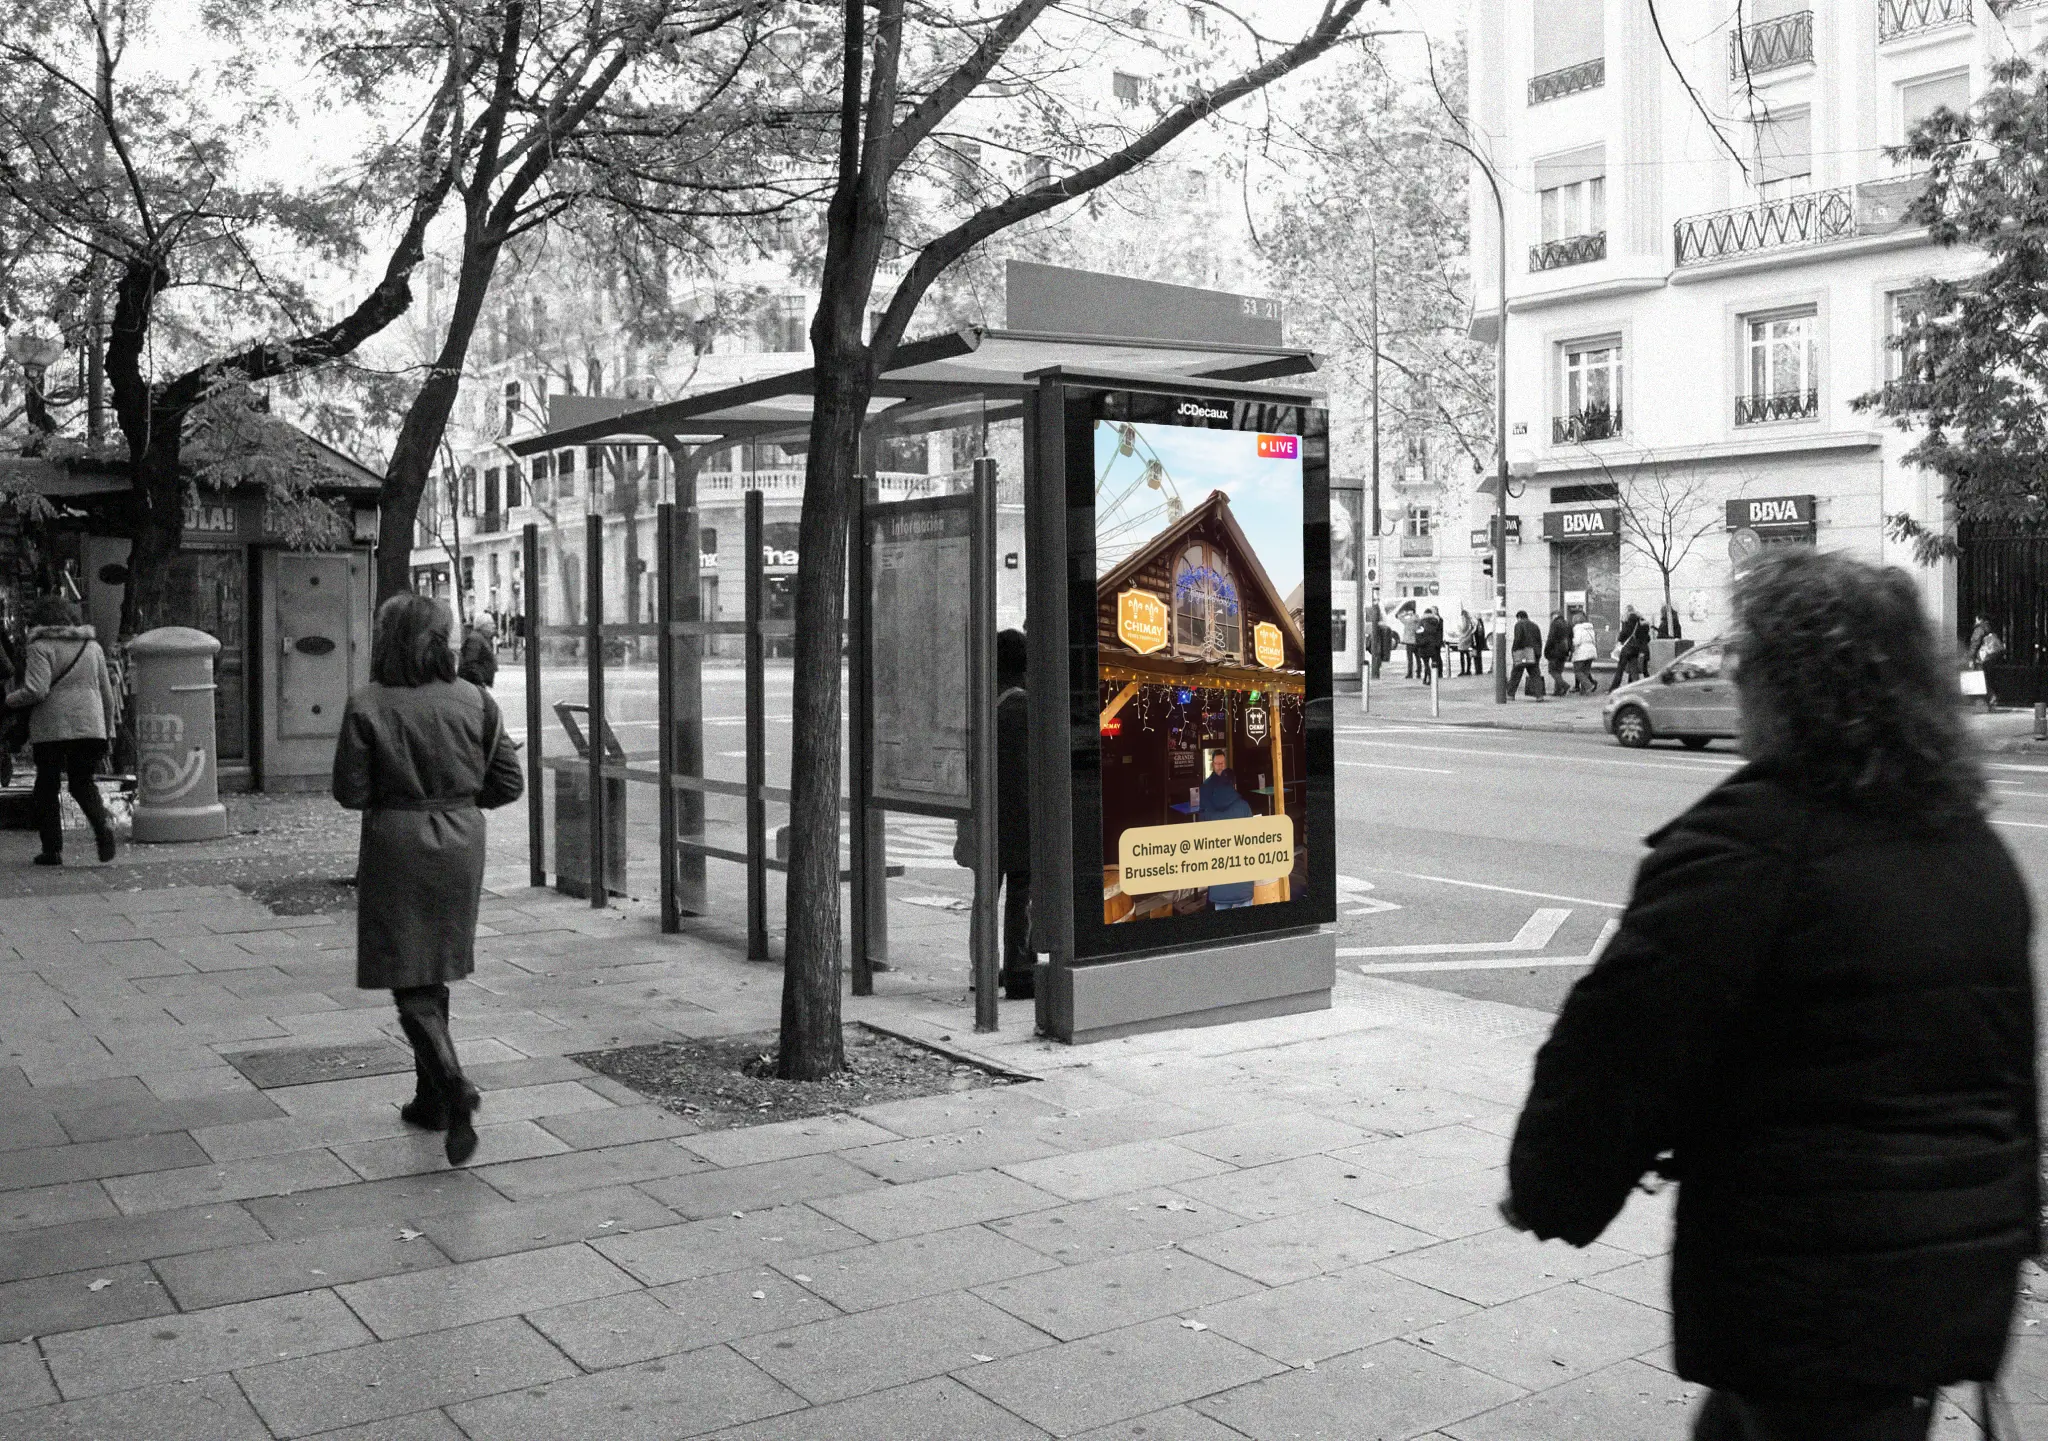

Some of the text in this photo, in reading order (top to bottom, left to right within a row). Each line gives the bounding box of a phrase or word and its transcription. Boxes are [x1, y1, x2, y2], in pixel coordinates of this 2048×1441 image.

[1265, 302, 1278, 318] 21
[1177, 403, 1229, 420] JCDecaux
[1269, 441, 1293, 453] LIVE
[1749, 500, 1798, 521] BBVA
[1562, 512, 1605, 533] BBVA
[1124, 619, 1163, 636] CHIMAY
[1132, 832, 1282, 857] Chimay @ Winter Wonders
[1125, 850, 1290, 880] Brussels: from 28/11 to 01/01
